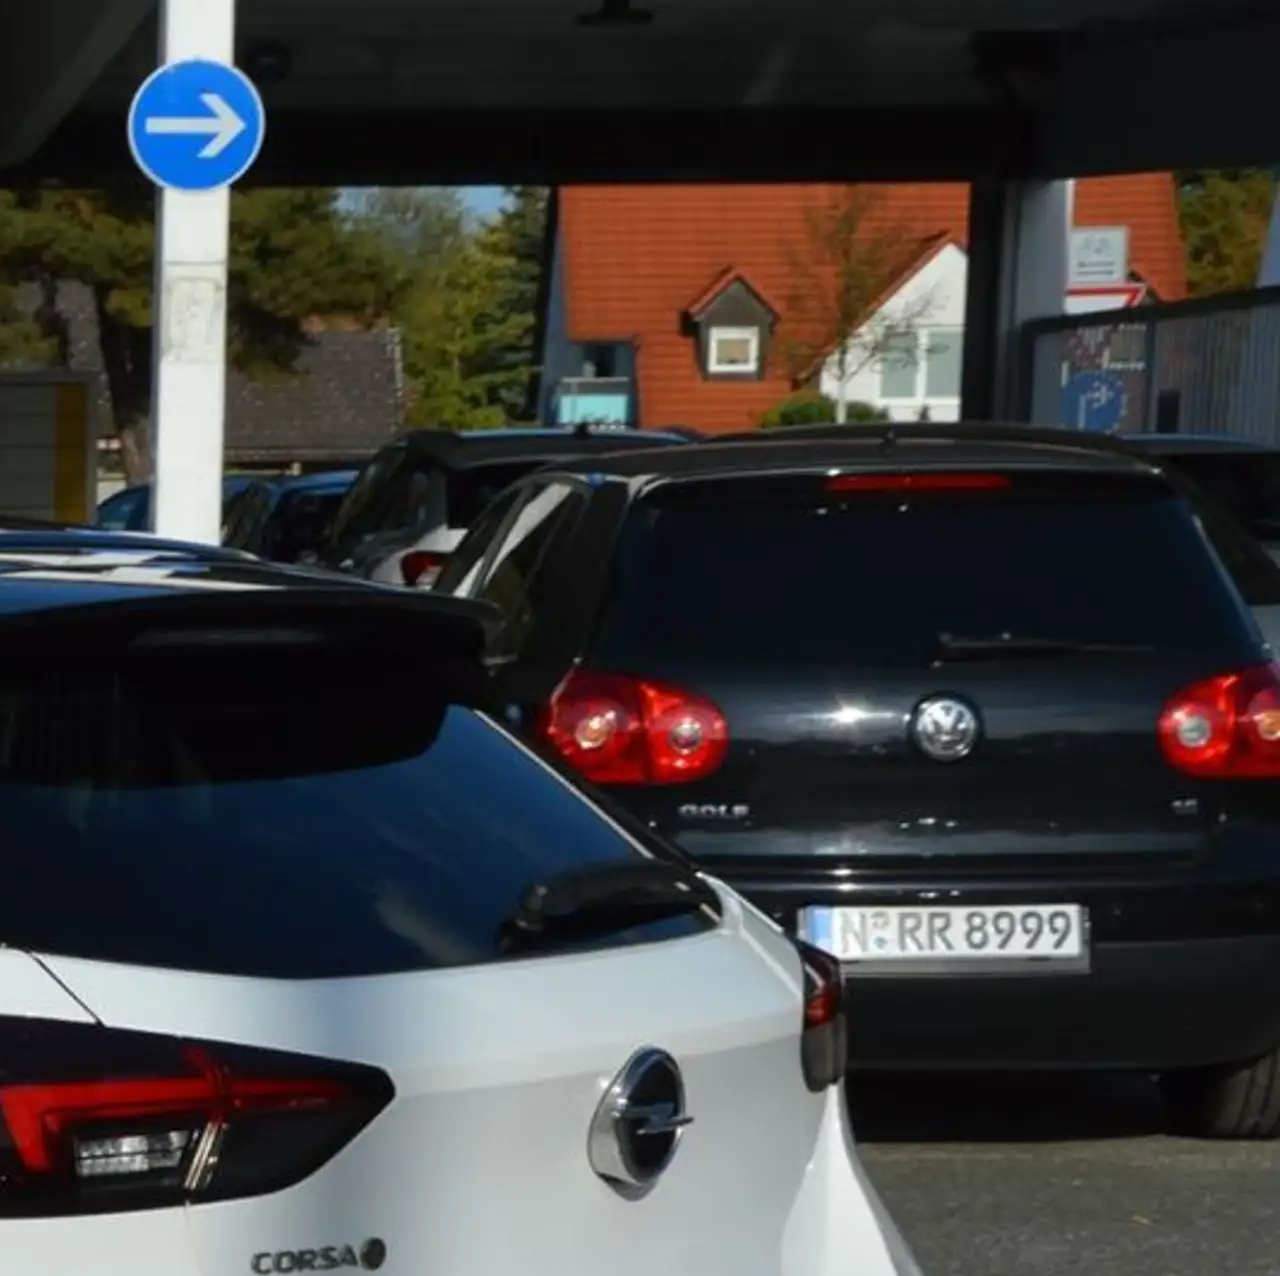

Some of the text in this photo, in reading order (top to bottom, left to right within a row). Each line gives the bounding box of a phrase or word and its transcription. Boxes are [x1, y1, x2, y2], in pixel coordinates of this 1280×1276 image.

[679, 804, 749, 820] GOLF
[841, 910, 1072, 953] N RR 8999
[251, 1244, 358, 1275] CORSA
